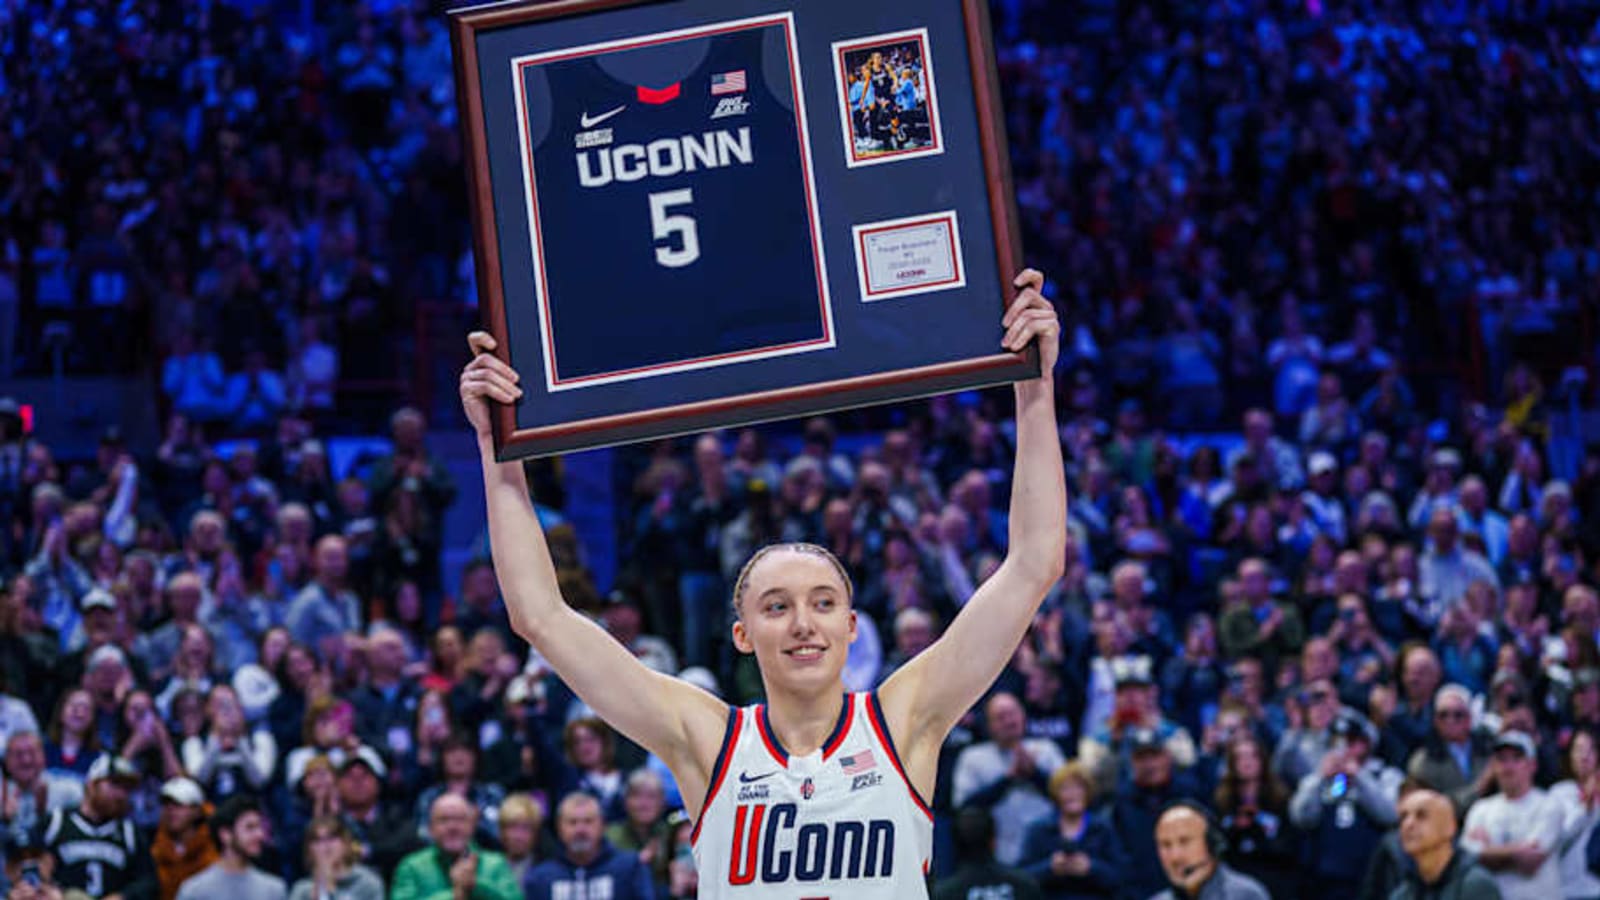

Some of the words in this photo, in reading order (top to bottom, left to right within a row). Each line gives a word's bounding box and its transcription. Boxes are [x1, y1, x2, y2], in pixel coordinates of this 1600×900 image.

[575, 126, 753, 188] UCONN
[649, 187, 701, 268] 5
[728, 803, 895, 886] UConn
